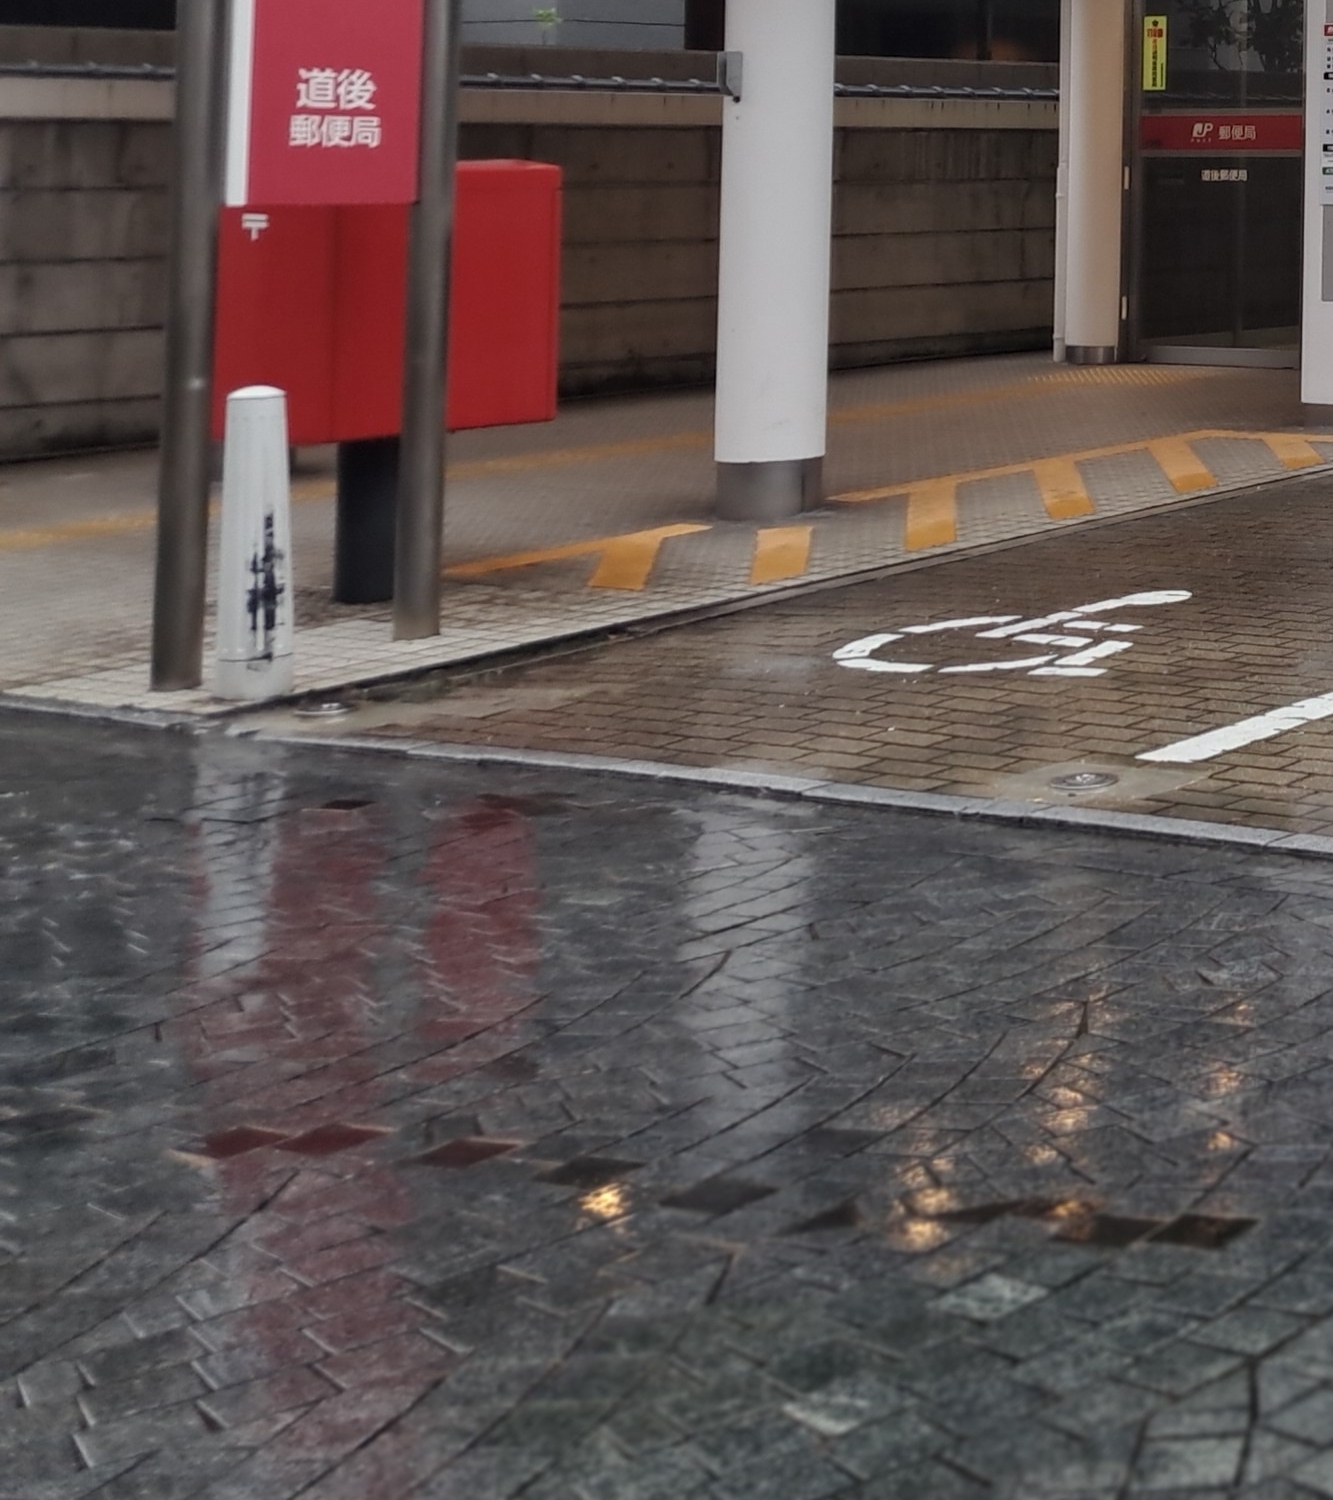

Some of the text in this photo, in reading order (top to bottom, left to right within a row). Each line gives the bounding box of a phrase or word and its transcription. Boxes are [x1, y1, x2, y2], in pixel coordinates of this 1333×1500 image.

[295, 66, 377, 111] 道後
[288, 113, 382, 149] 郵便局
[1218, 125, 1257, 140] 郵便局
[1201, 169, 1248, 182] 道後郵便局
